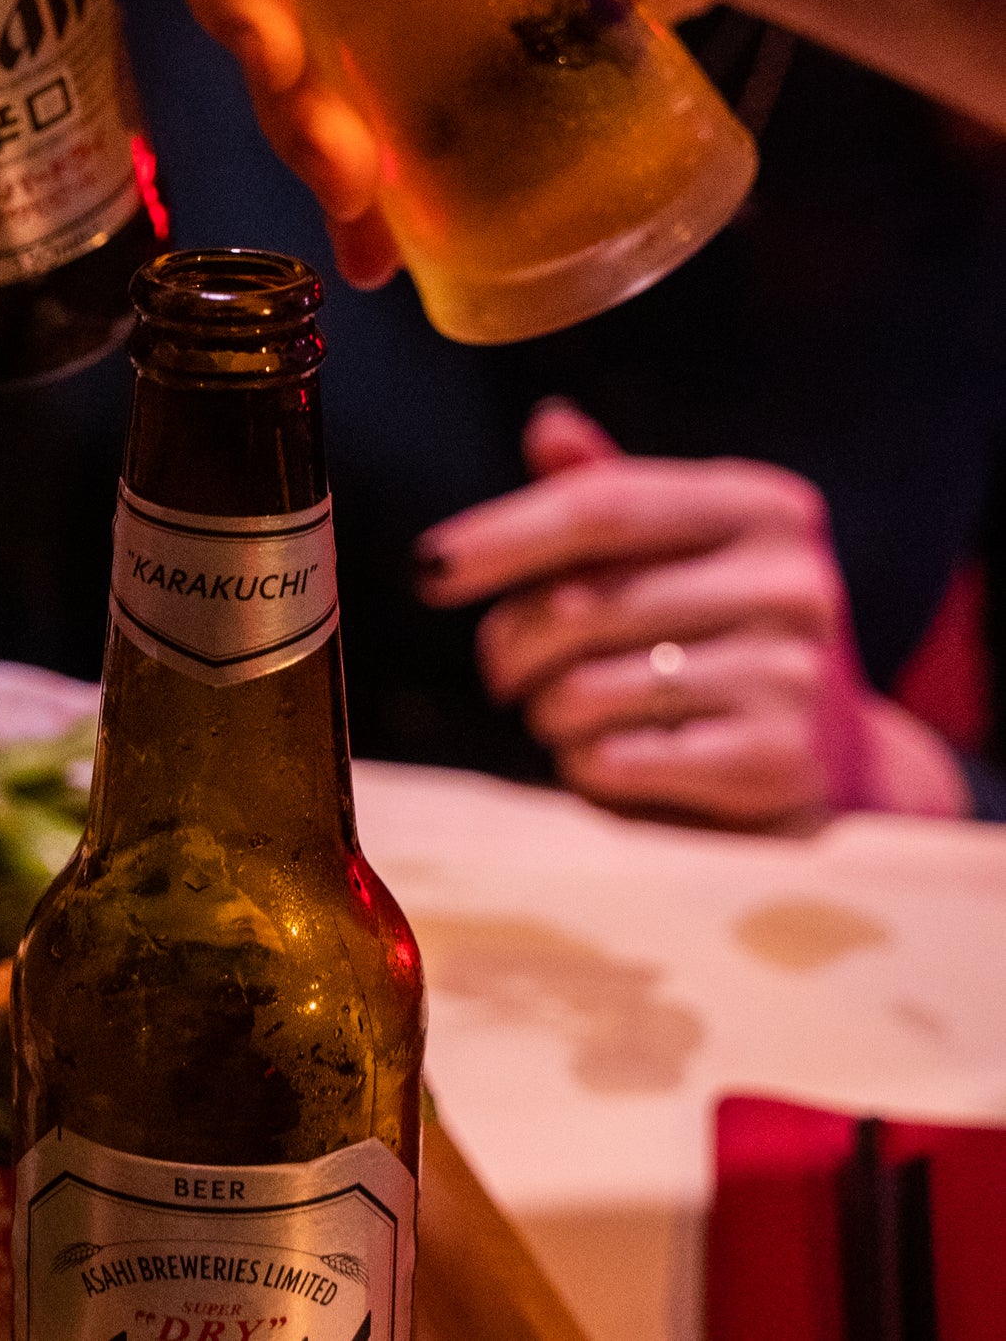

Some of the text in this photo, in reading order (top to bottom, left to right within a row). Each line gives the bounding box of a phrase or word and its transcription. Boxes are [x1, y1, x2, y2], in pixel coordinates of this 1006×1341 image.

[127, 549, 319, 601] "KARAKUCHI"
[174, 1177, 245, 1199] BEER
[81, 1255, 338, 1307] ASAHI BREWERIES LIMITED
[181, 1301, 244, 1317] SUPER
